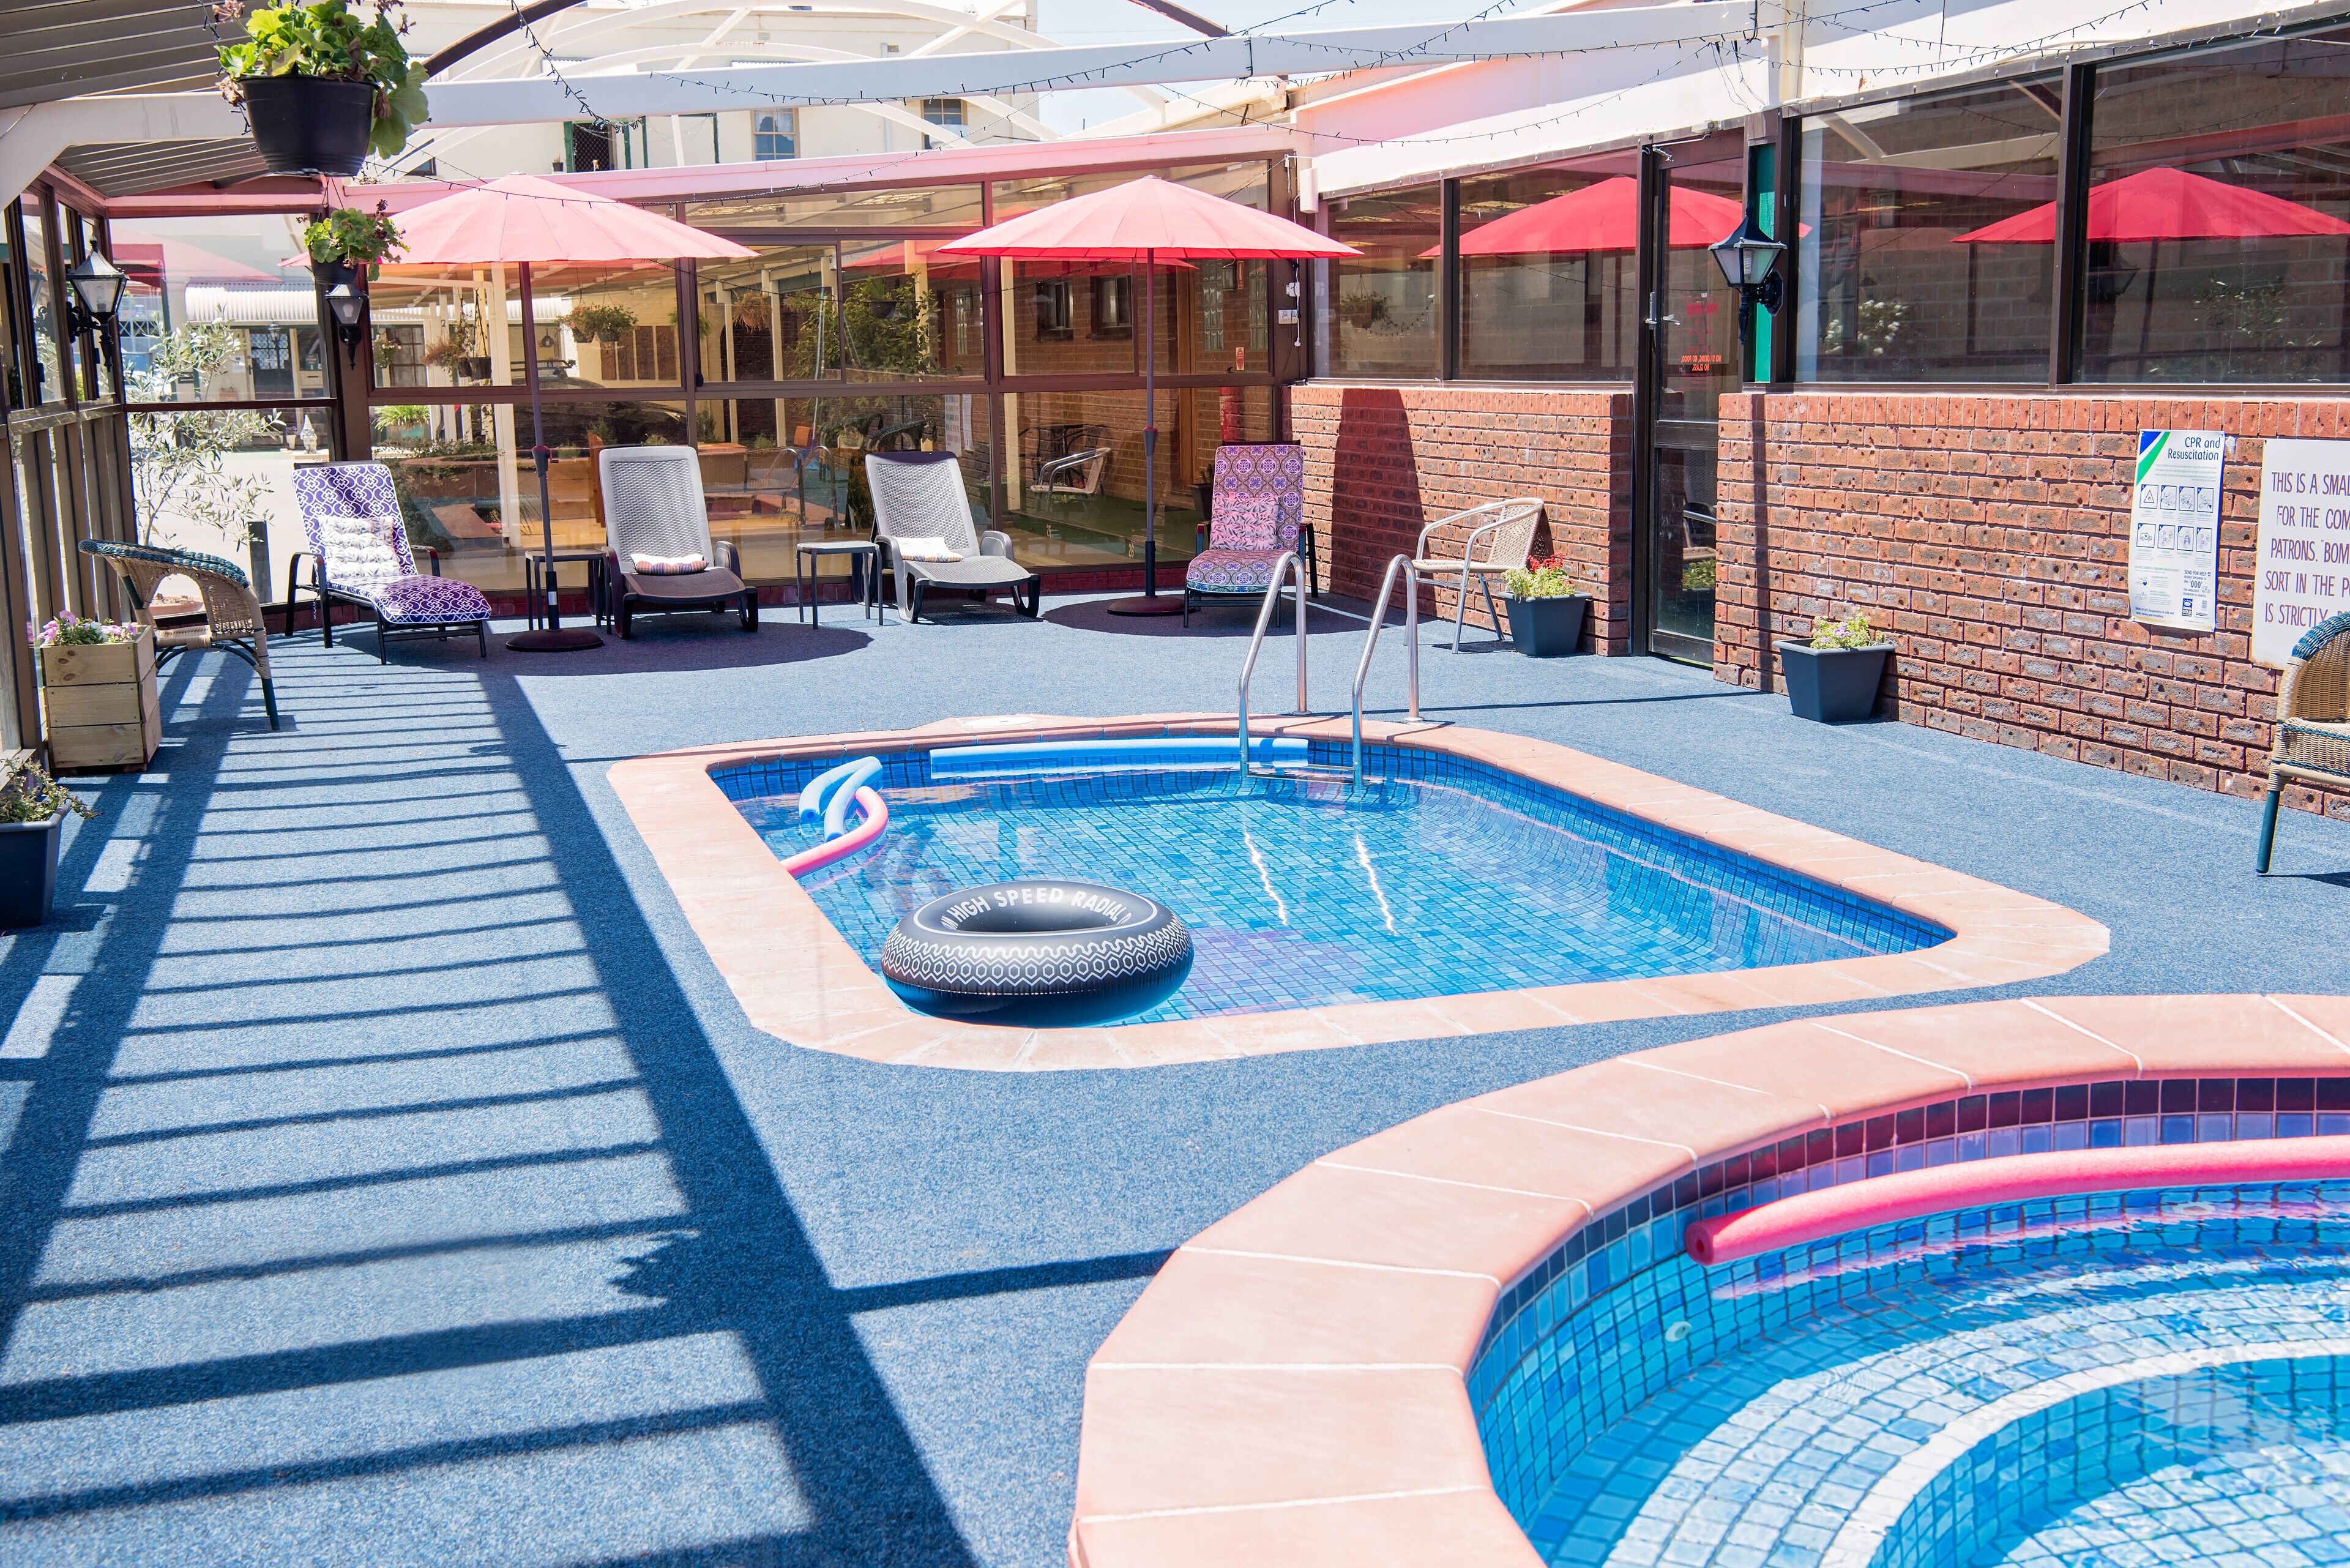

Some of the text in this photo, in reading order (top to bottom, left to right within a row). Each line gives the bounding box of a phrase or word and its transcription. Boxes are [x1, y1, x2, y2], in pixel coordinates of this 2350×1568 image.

[2168, 448, 2219, 460] Resuscitation
[2185, 436, 2221, 449] CPR and
[2272, 472, 2293, 493] THIS
[2296, 472, 2306, 493] IS
[2309, 474, 2318, 494] A
[2277, 505, 2296, 526] FOR
[2300, 507, 2320, 528] THE
[2270, 538, 2318, 562] PATRONS.
[2264, 570, 2350, 597] SORT IN THE P
[2265, 602, 2328, 627] IS STRICTLY
[946, 896, 991, 923] HIGH
[994, 887, 1064, 908] SPEED
[1071, 890, 1127, 922] RADIAL
